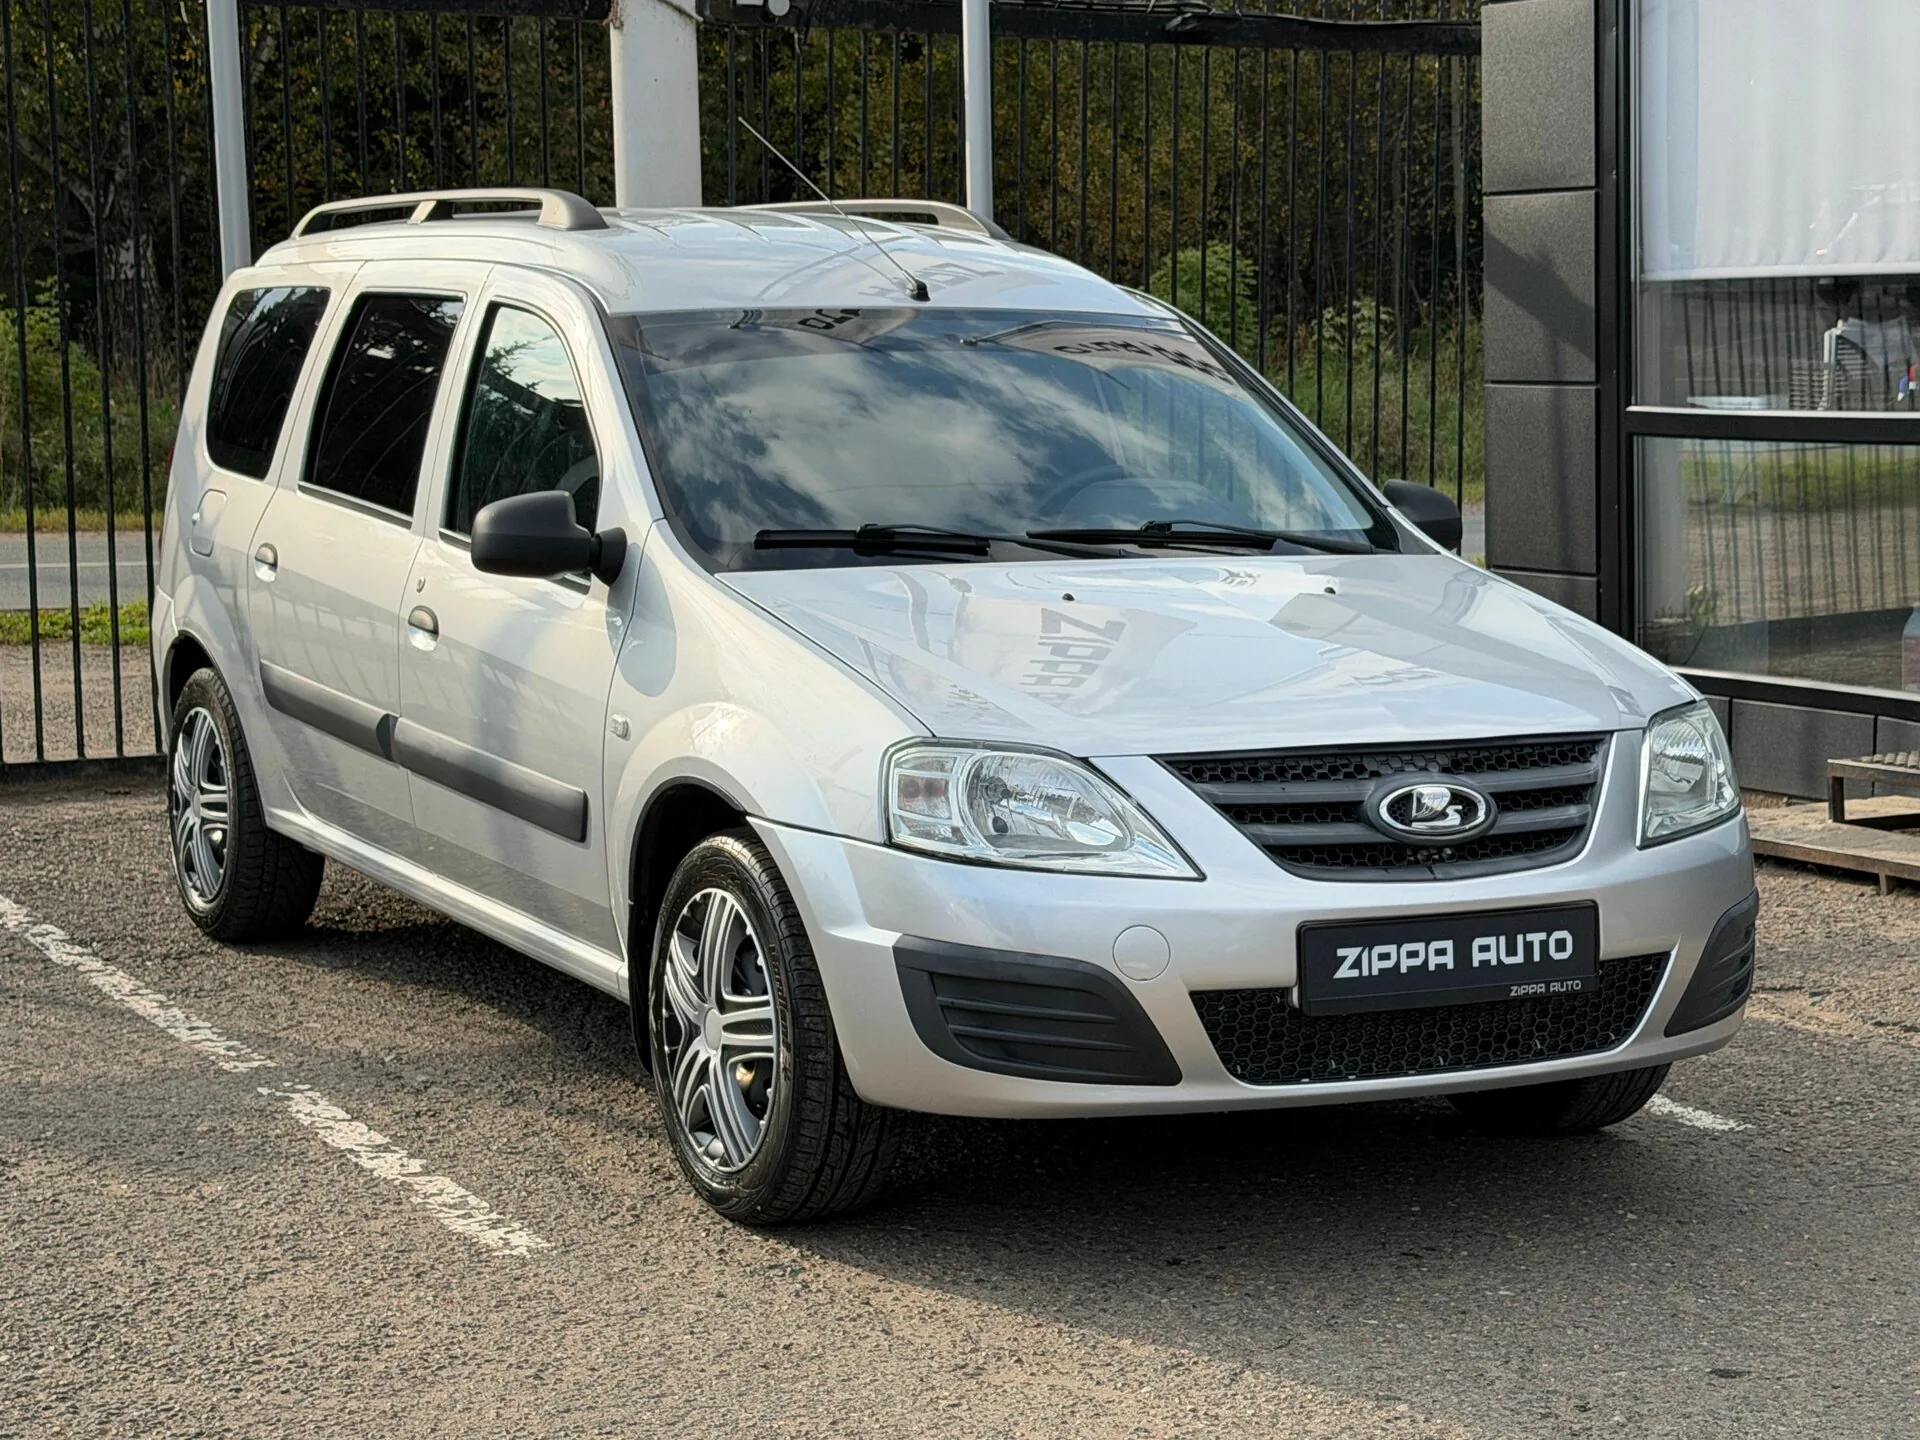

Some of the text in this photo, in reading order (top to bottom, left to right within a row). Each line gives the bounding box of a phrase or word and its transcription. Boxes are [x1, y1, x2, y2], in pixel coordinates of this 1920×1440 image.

[1333, 930, 1573, 979] ZIPPA AUTO
[1509, 980, 1582, 997] ZIPPA AUTO
